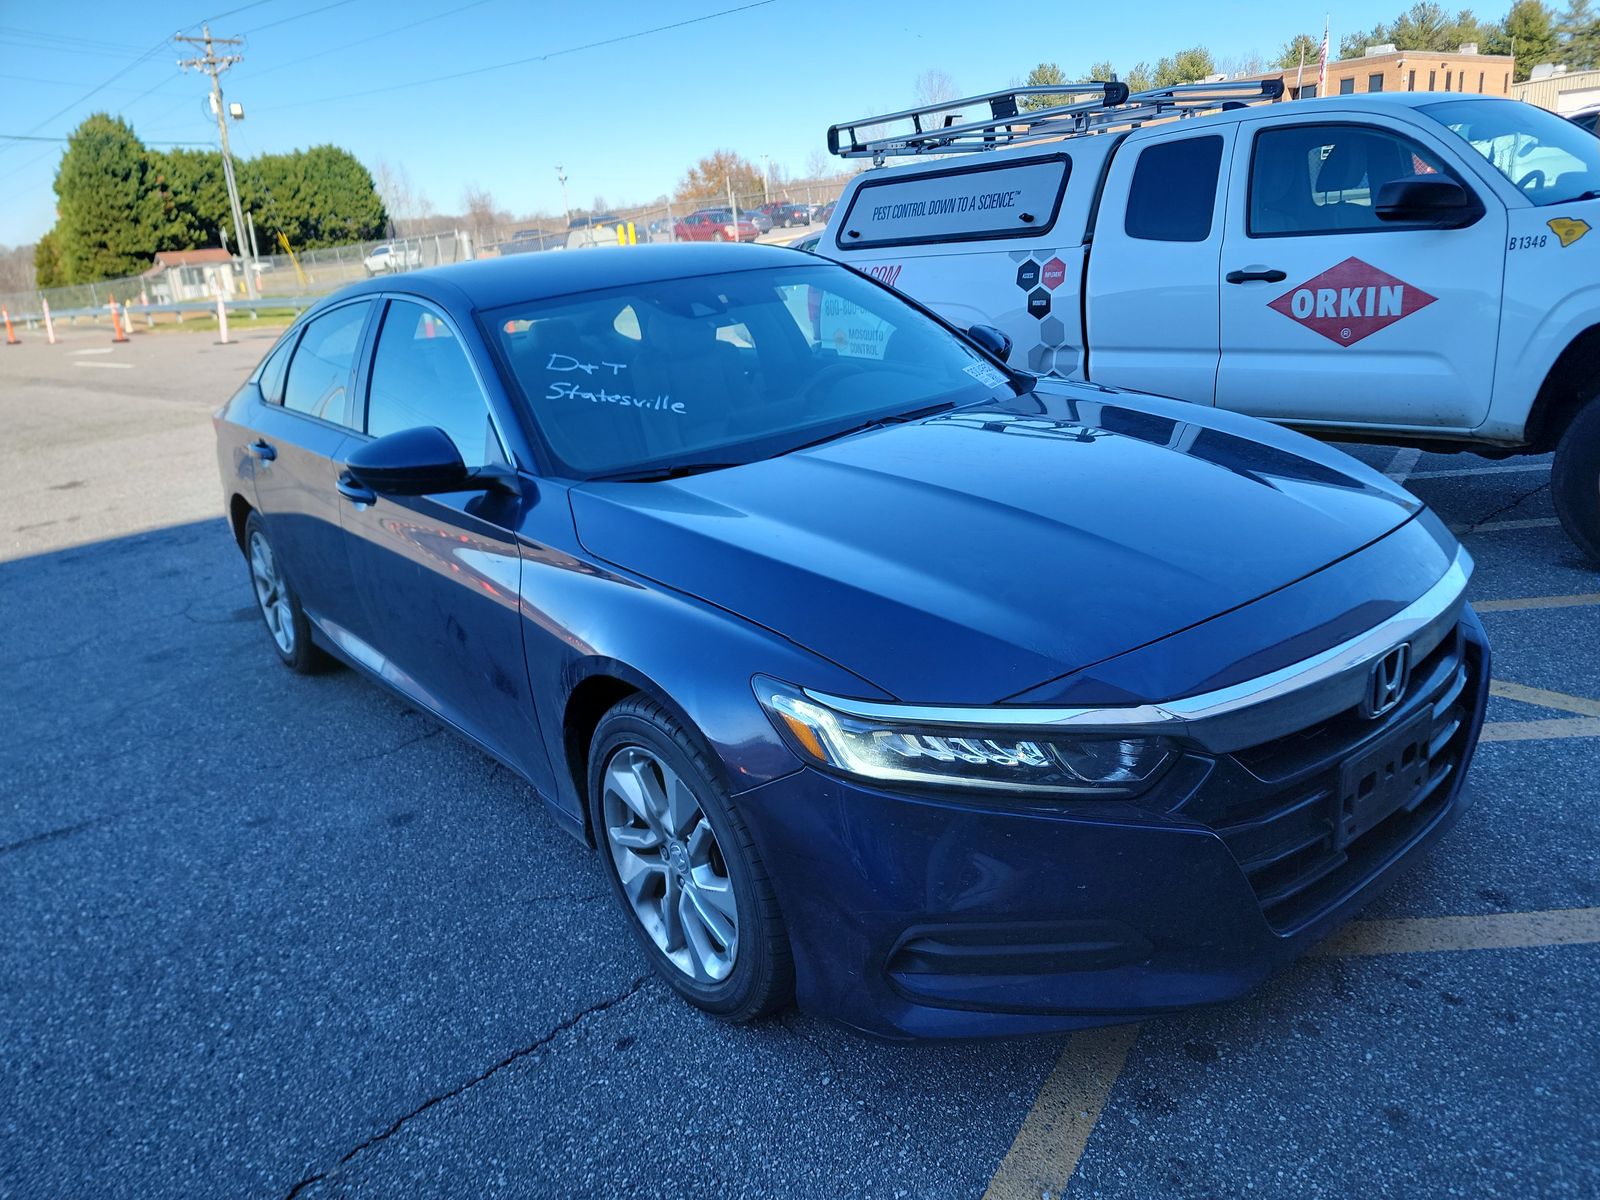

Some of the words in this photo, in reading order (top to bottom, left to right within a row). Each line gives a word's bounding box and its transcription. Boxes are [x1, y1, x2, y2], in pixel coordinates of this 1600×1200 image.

[872, 205, 893, 221] PEST
[892, 202, 927, 219] CONTROL
[928, 198, 957, 215] DOWN
[957, 196, 970, 213] TO
[968, 195, 976, 211] A
[1291, 285, 1404, 319] ORKIN
[848, 328, 884, 341] MOSQUITO
[849, 343, 880, 355] CONTROL
[545, 382, 687, 414] Statesville
